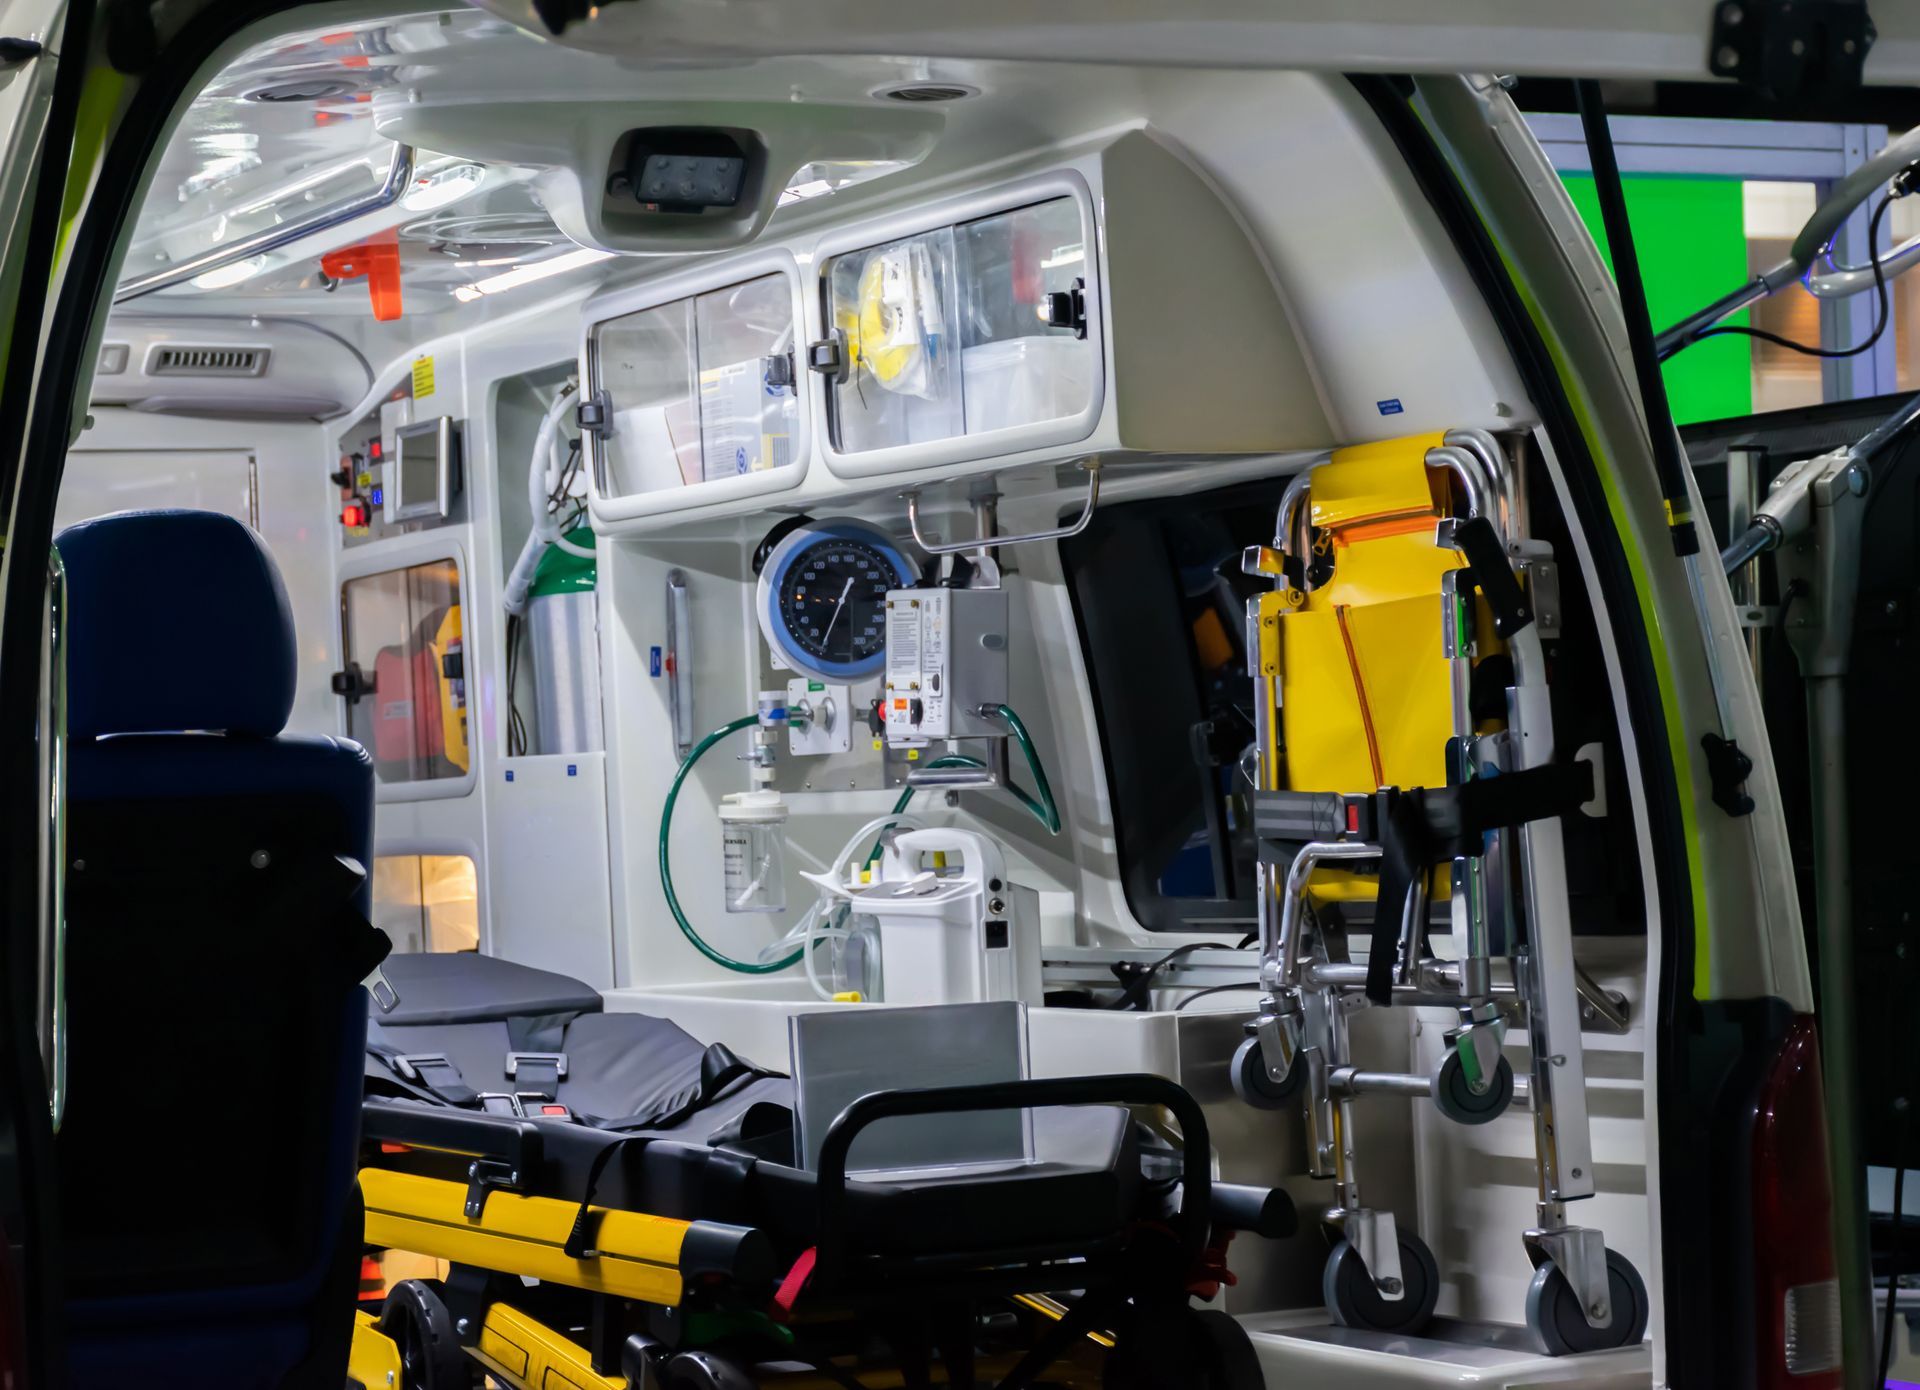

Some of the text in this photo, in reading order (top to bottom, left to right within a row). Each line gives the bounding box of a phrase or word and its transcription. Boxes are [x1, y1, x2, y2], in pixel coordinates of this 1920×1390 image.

[814, 562, 825, 570] 120
[874, 584, 886, 592] 220
[800, 616, 808, 624] 40
[810, 628, 818, 636] 20
